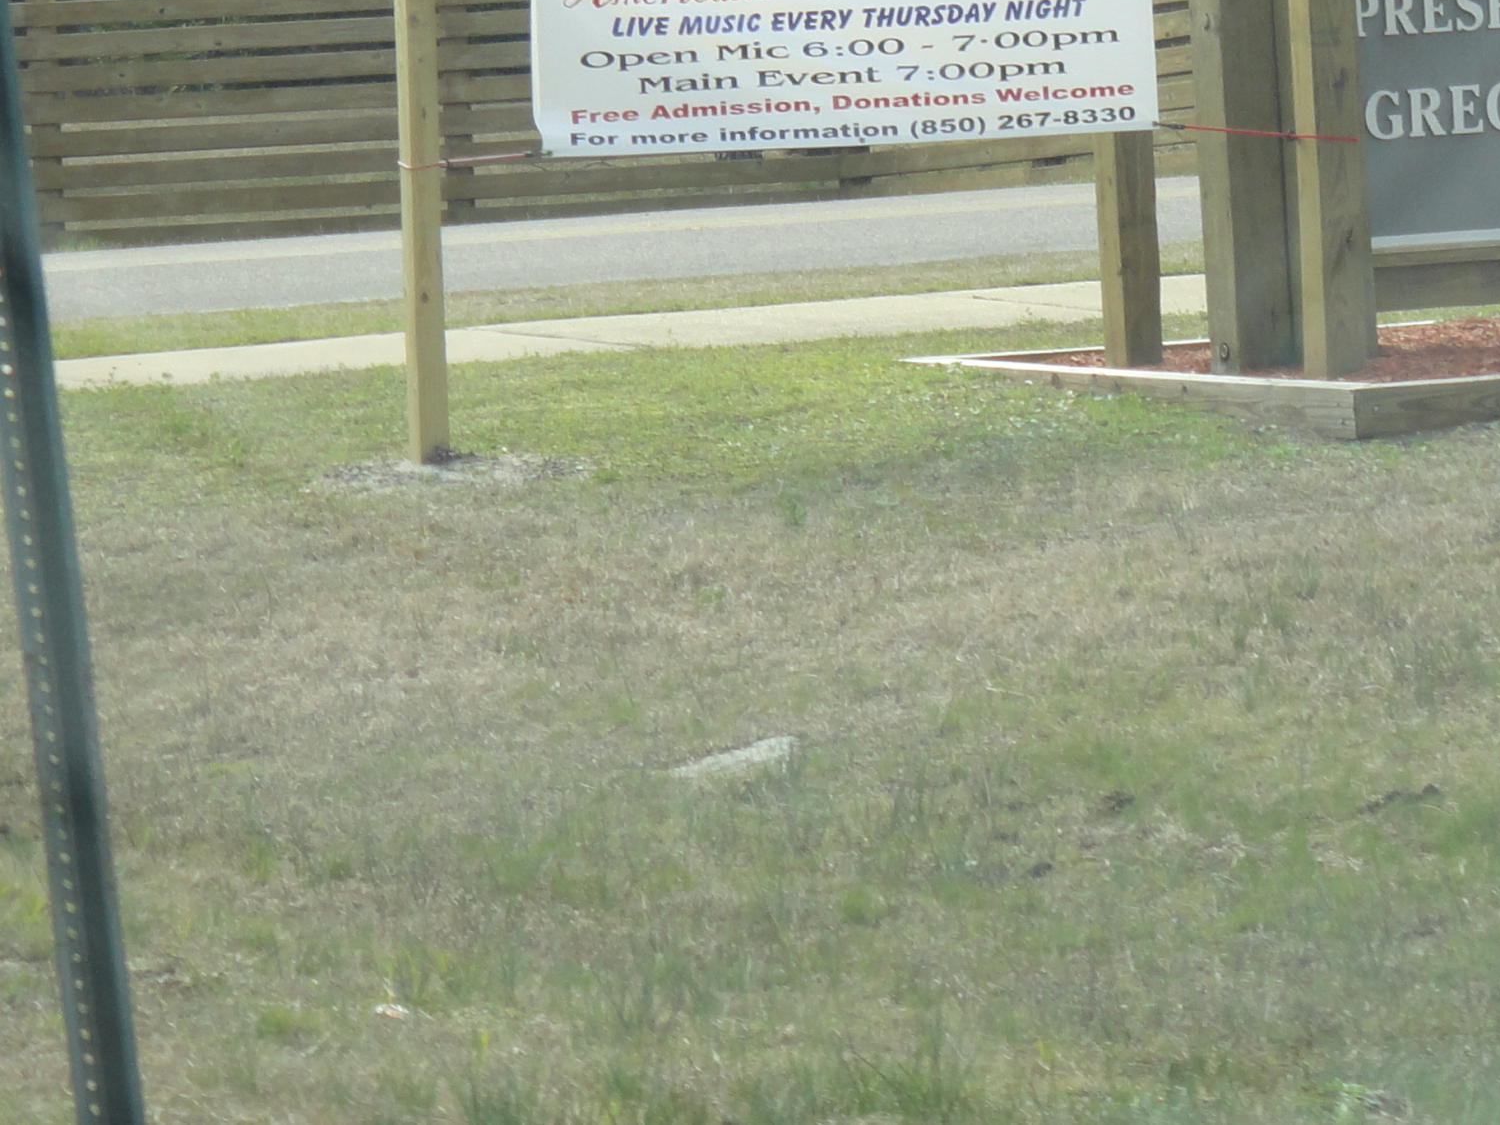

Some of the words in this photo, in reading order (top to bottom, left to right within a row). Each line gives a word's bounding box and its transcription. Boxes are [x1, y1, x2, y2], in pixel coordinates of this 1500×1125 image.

[611, 15, 670, 38] LIVE
[678, 13, 762, 36] MUSIC
[771, 8, 853, 32] EVERY
[861, 2, 997, 28] THURSDAY
[579, 49, 699, 72] Open
[716, 41, 790, 62] Mic
[802, 37, 906, 58] 6:00
[638, 73, 740, 95] Main
[756, 66, 883, 89] Event
[896, 60, 1067, 82] 7:00pm
[570, 109, 640, 125] Free
[650, 98, 821, 121] Admission,
[832, 91, 987, 111] Donations
[995, 82, 1136, 103] Welcome
[569, 131, 619, 147] For
[631, 131, 710, 145] more
[719, 122, 899, 142] information
[910, 116, 987, 140] (850)
[997, 105, 1137, 131] 267-8330
